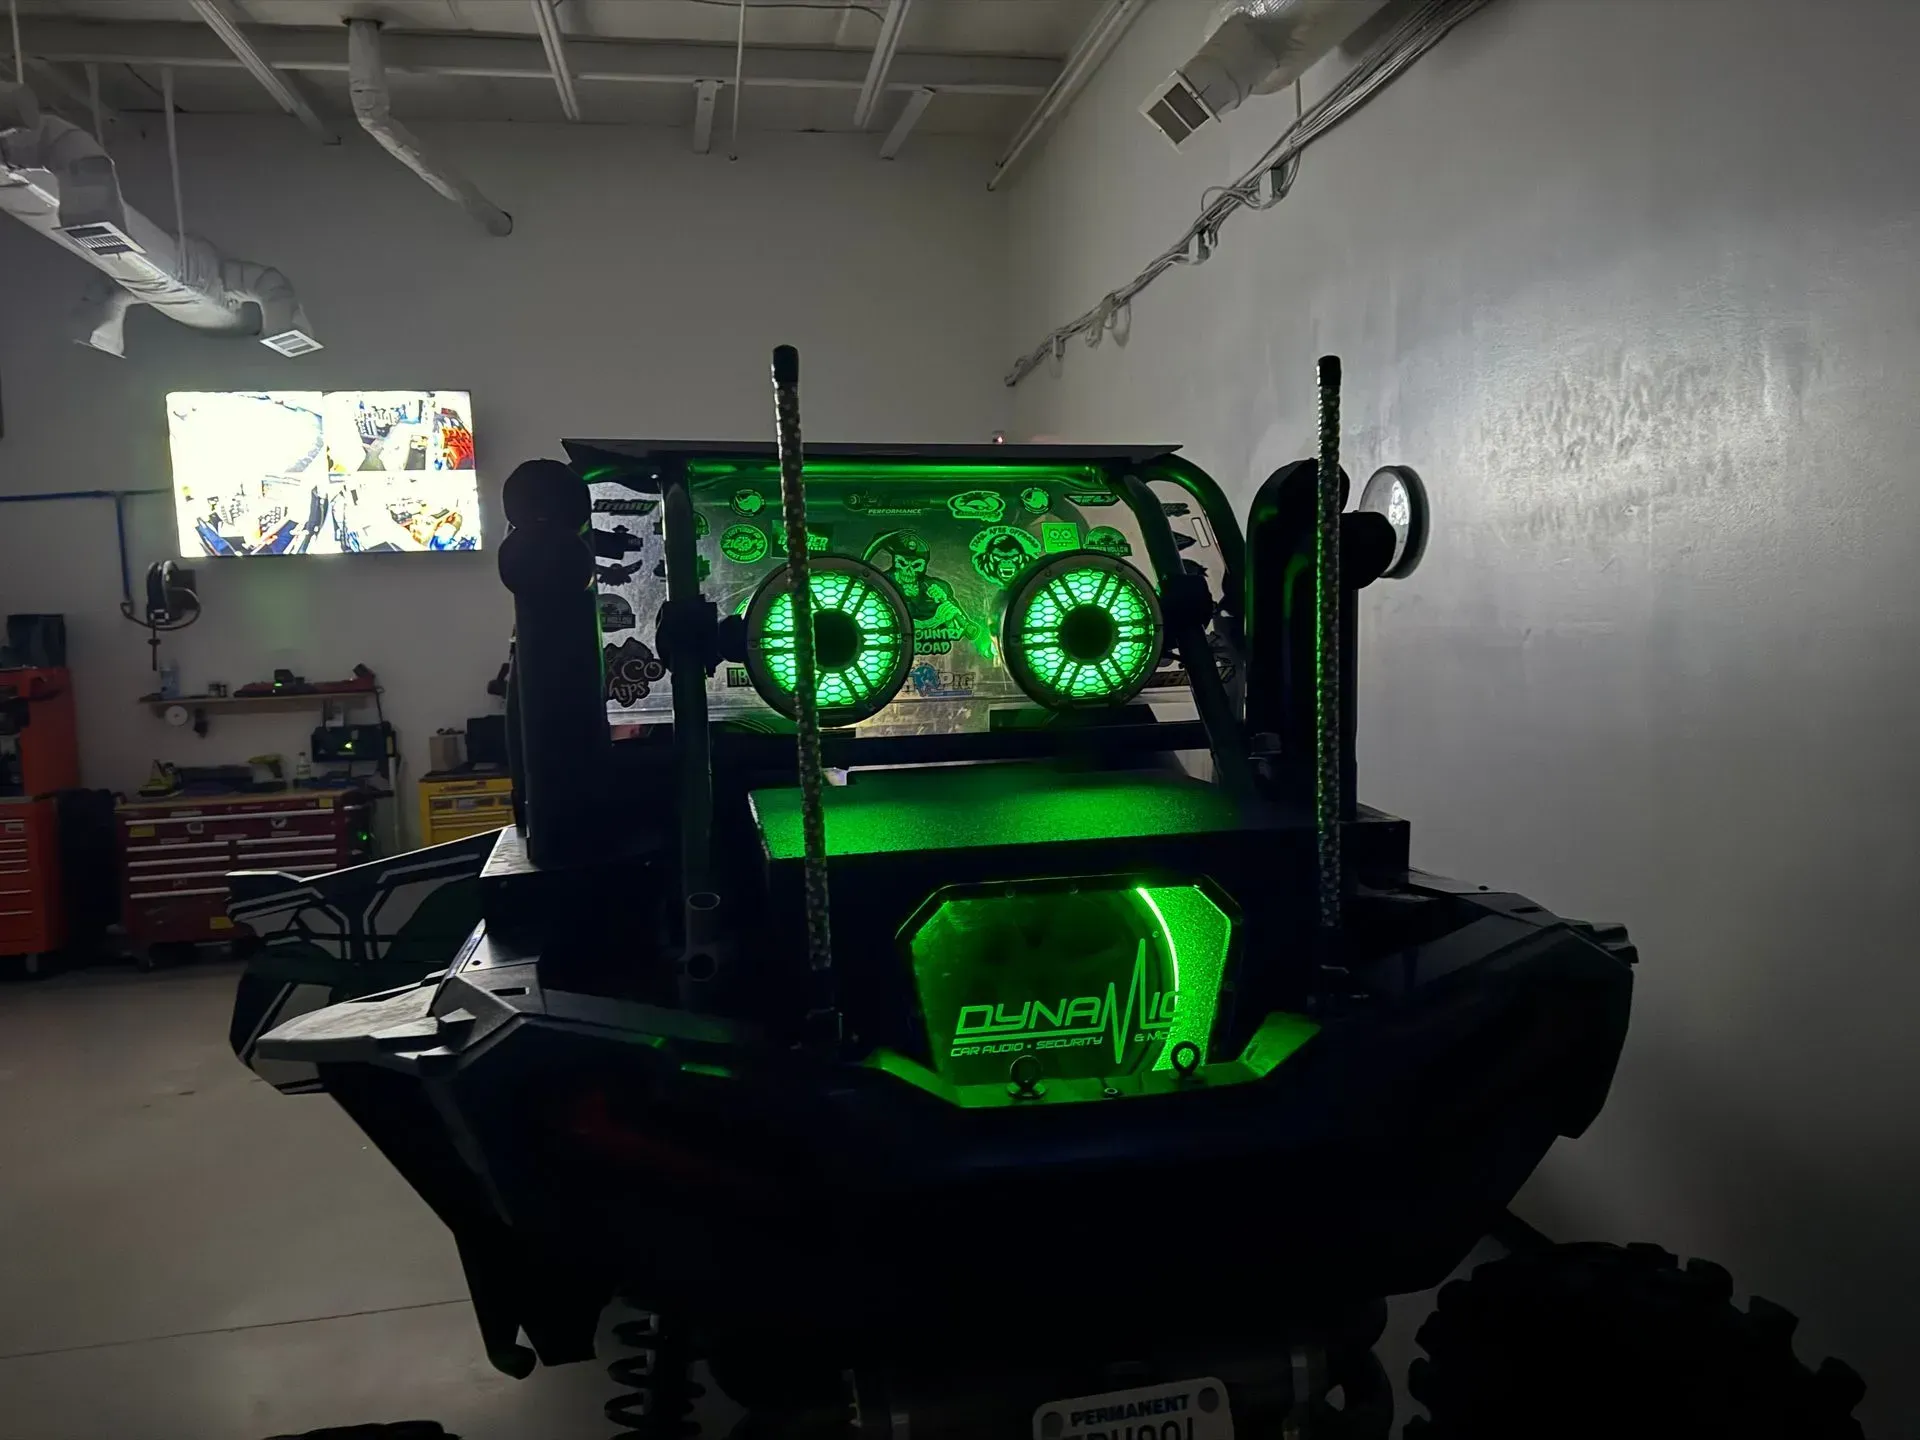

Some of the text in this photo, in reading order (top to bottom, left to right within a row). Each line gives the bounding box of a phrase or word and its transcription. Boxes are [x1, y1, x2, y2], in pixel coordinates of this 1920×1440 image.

[914, 628, 964, 641] OUNTRY
[914, 641, 951, 654] ROAD
[955, 938, 1195, 1063] DYNAMIC
[950, 1046, 980, 1057] CAR
[982, 1042, 1024, 1055] AUDIO
[1036, 1036, 1104, 1049] SECURITY
[1070, 1394, 1190, 1427] PERMANENT
